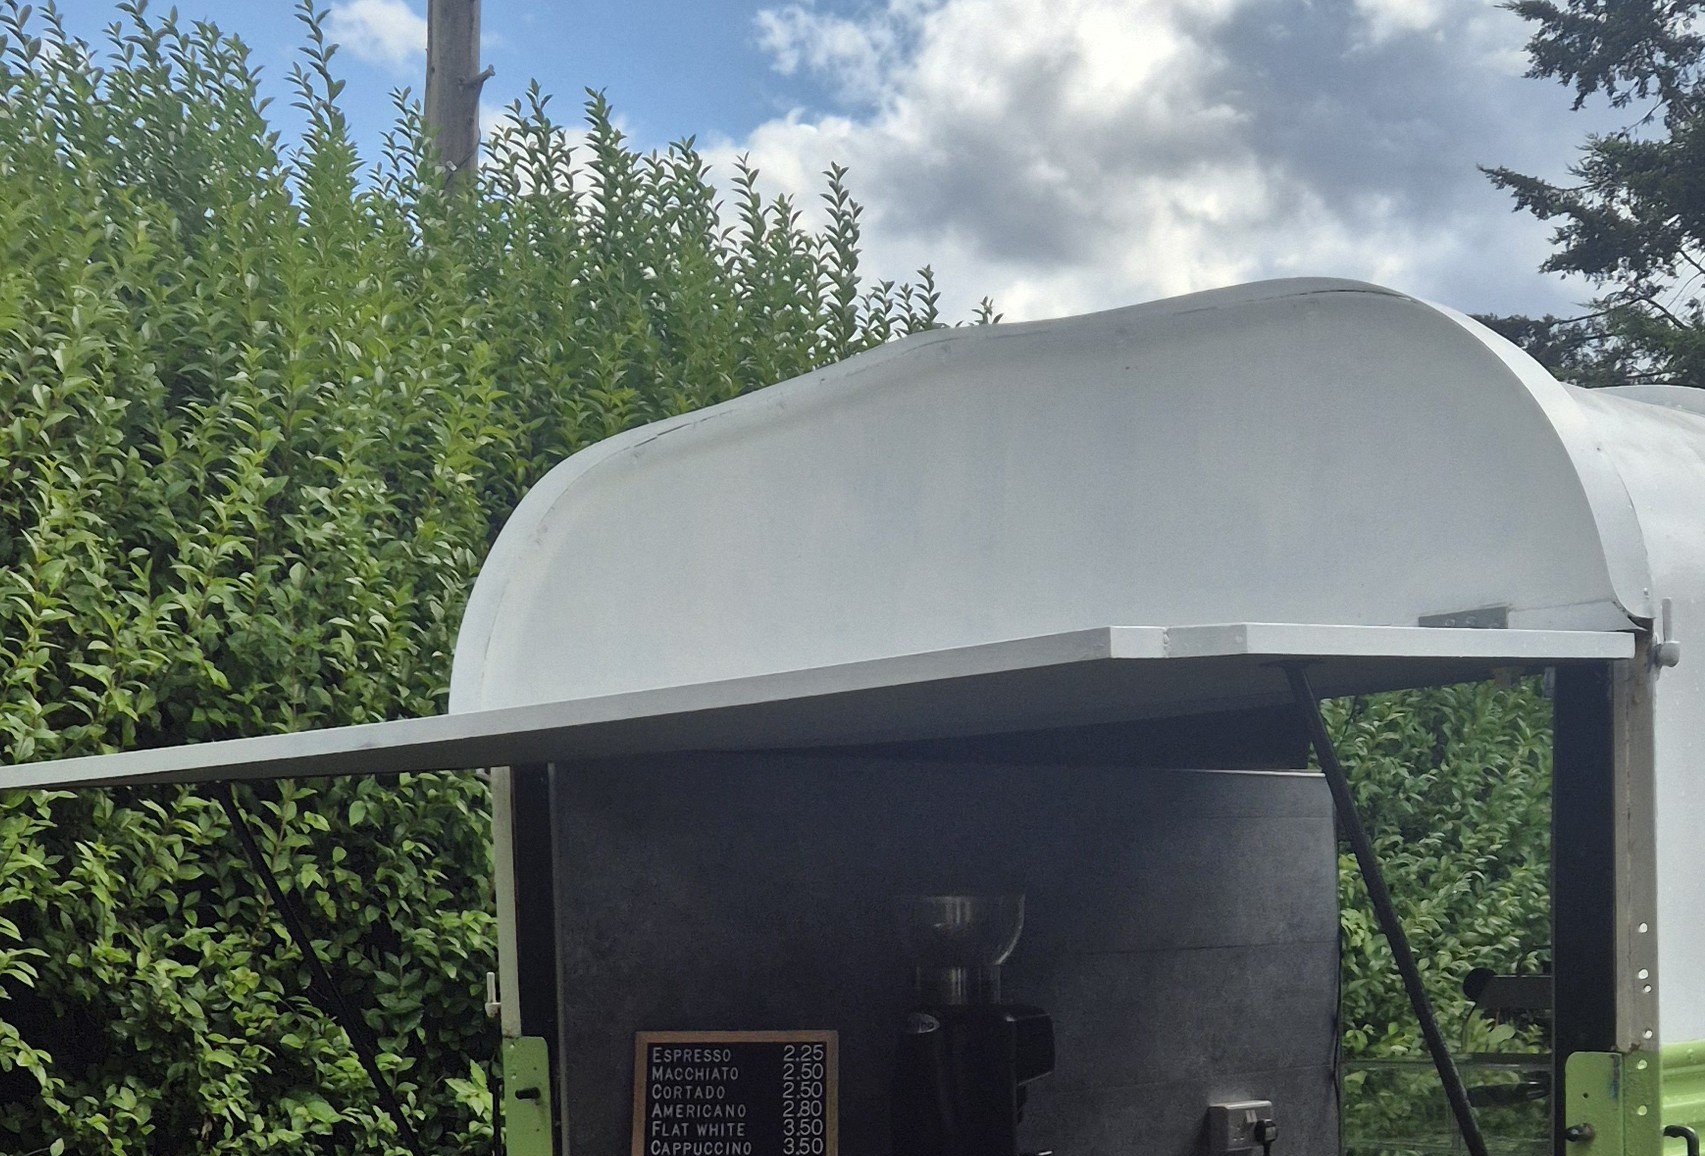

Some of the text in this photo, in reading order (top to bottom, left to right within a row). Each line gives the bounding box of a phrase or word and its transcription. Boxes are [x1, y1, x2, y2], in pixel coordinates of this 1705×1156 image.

[652, 1044, 824, 1064] ESPRESSO 2.25
[652, 1063, 824, 1081] MACCHIATO 2.50
[652, 1082, 823, 1100] CORTADO 2.50
[651, 1101, 823, 1119] AMERICANO 2.80
[652, 1119, 823, 1138] FLAT WHITE 3.50
[650, 1138, 824, 1156] CAPPUCCINO 3.50
